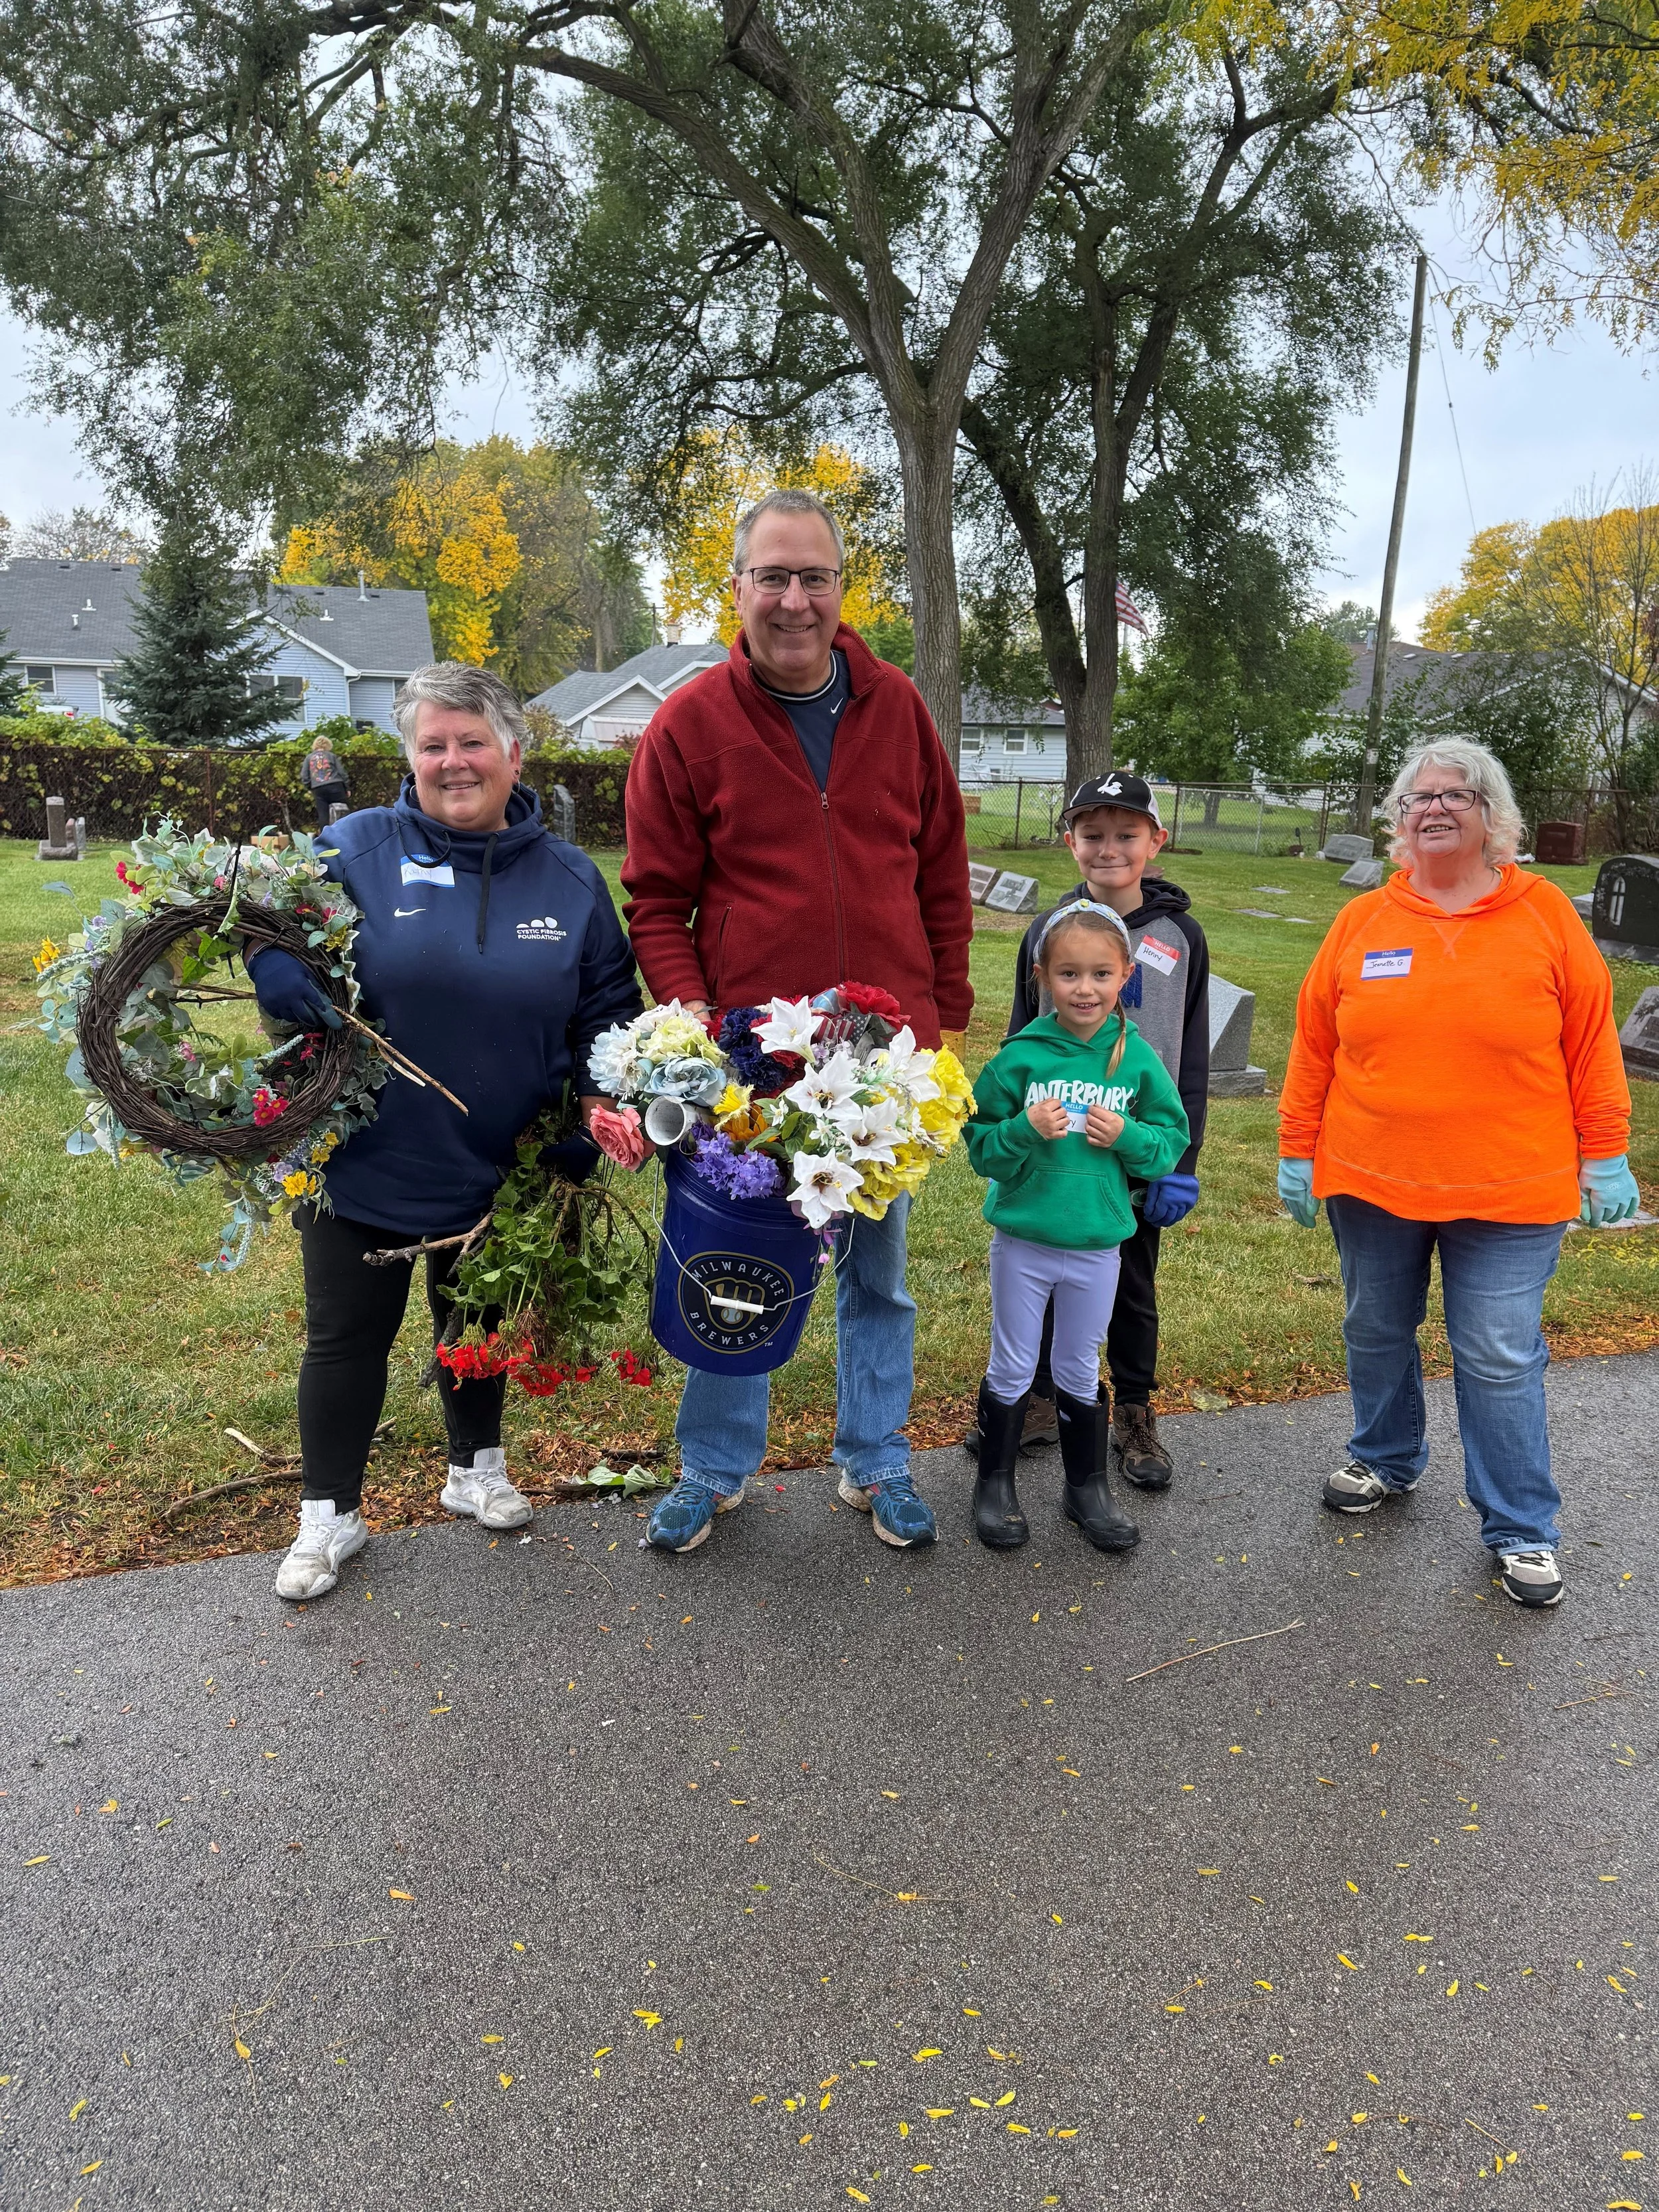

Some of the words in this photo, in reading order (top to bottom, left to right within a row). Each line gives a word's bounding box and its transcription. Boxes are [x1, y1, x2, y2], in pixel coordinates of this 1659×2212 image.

[1143, 946, 1163, 961] Henry
[1155, 940, 1171, 952] HELLO
[1024, 1079, 1134, 1112] ANTERBURY
[691, 1261, 784, 1296] MILWAUKEE
[690, 1311, 769, 1345] BREWERS
